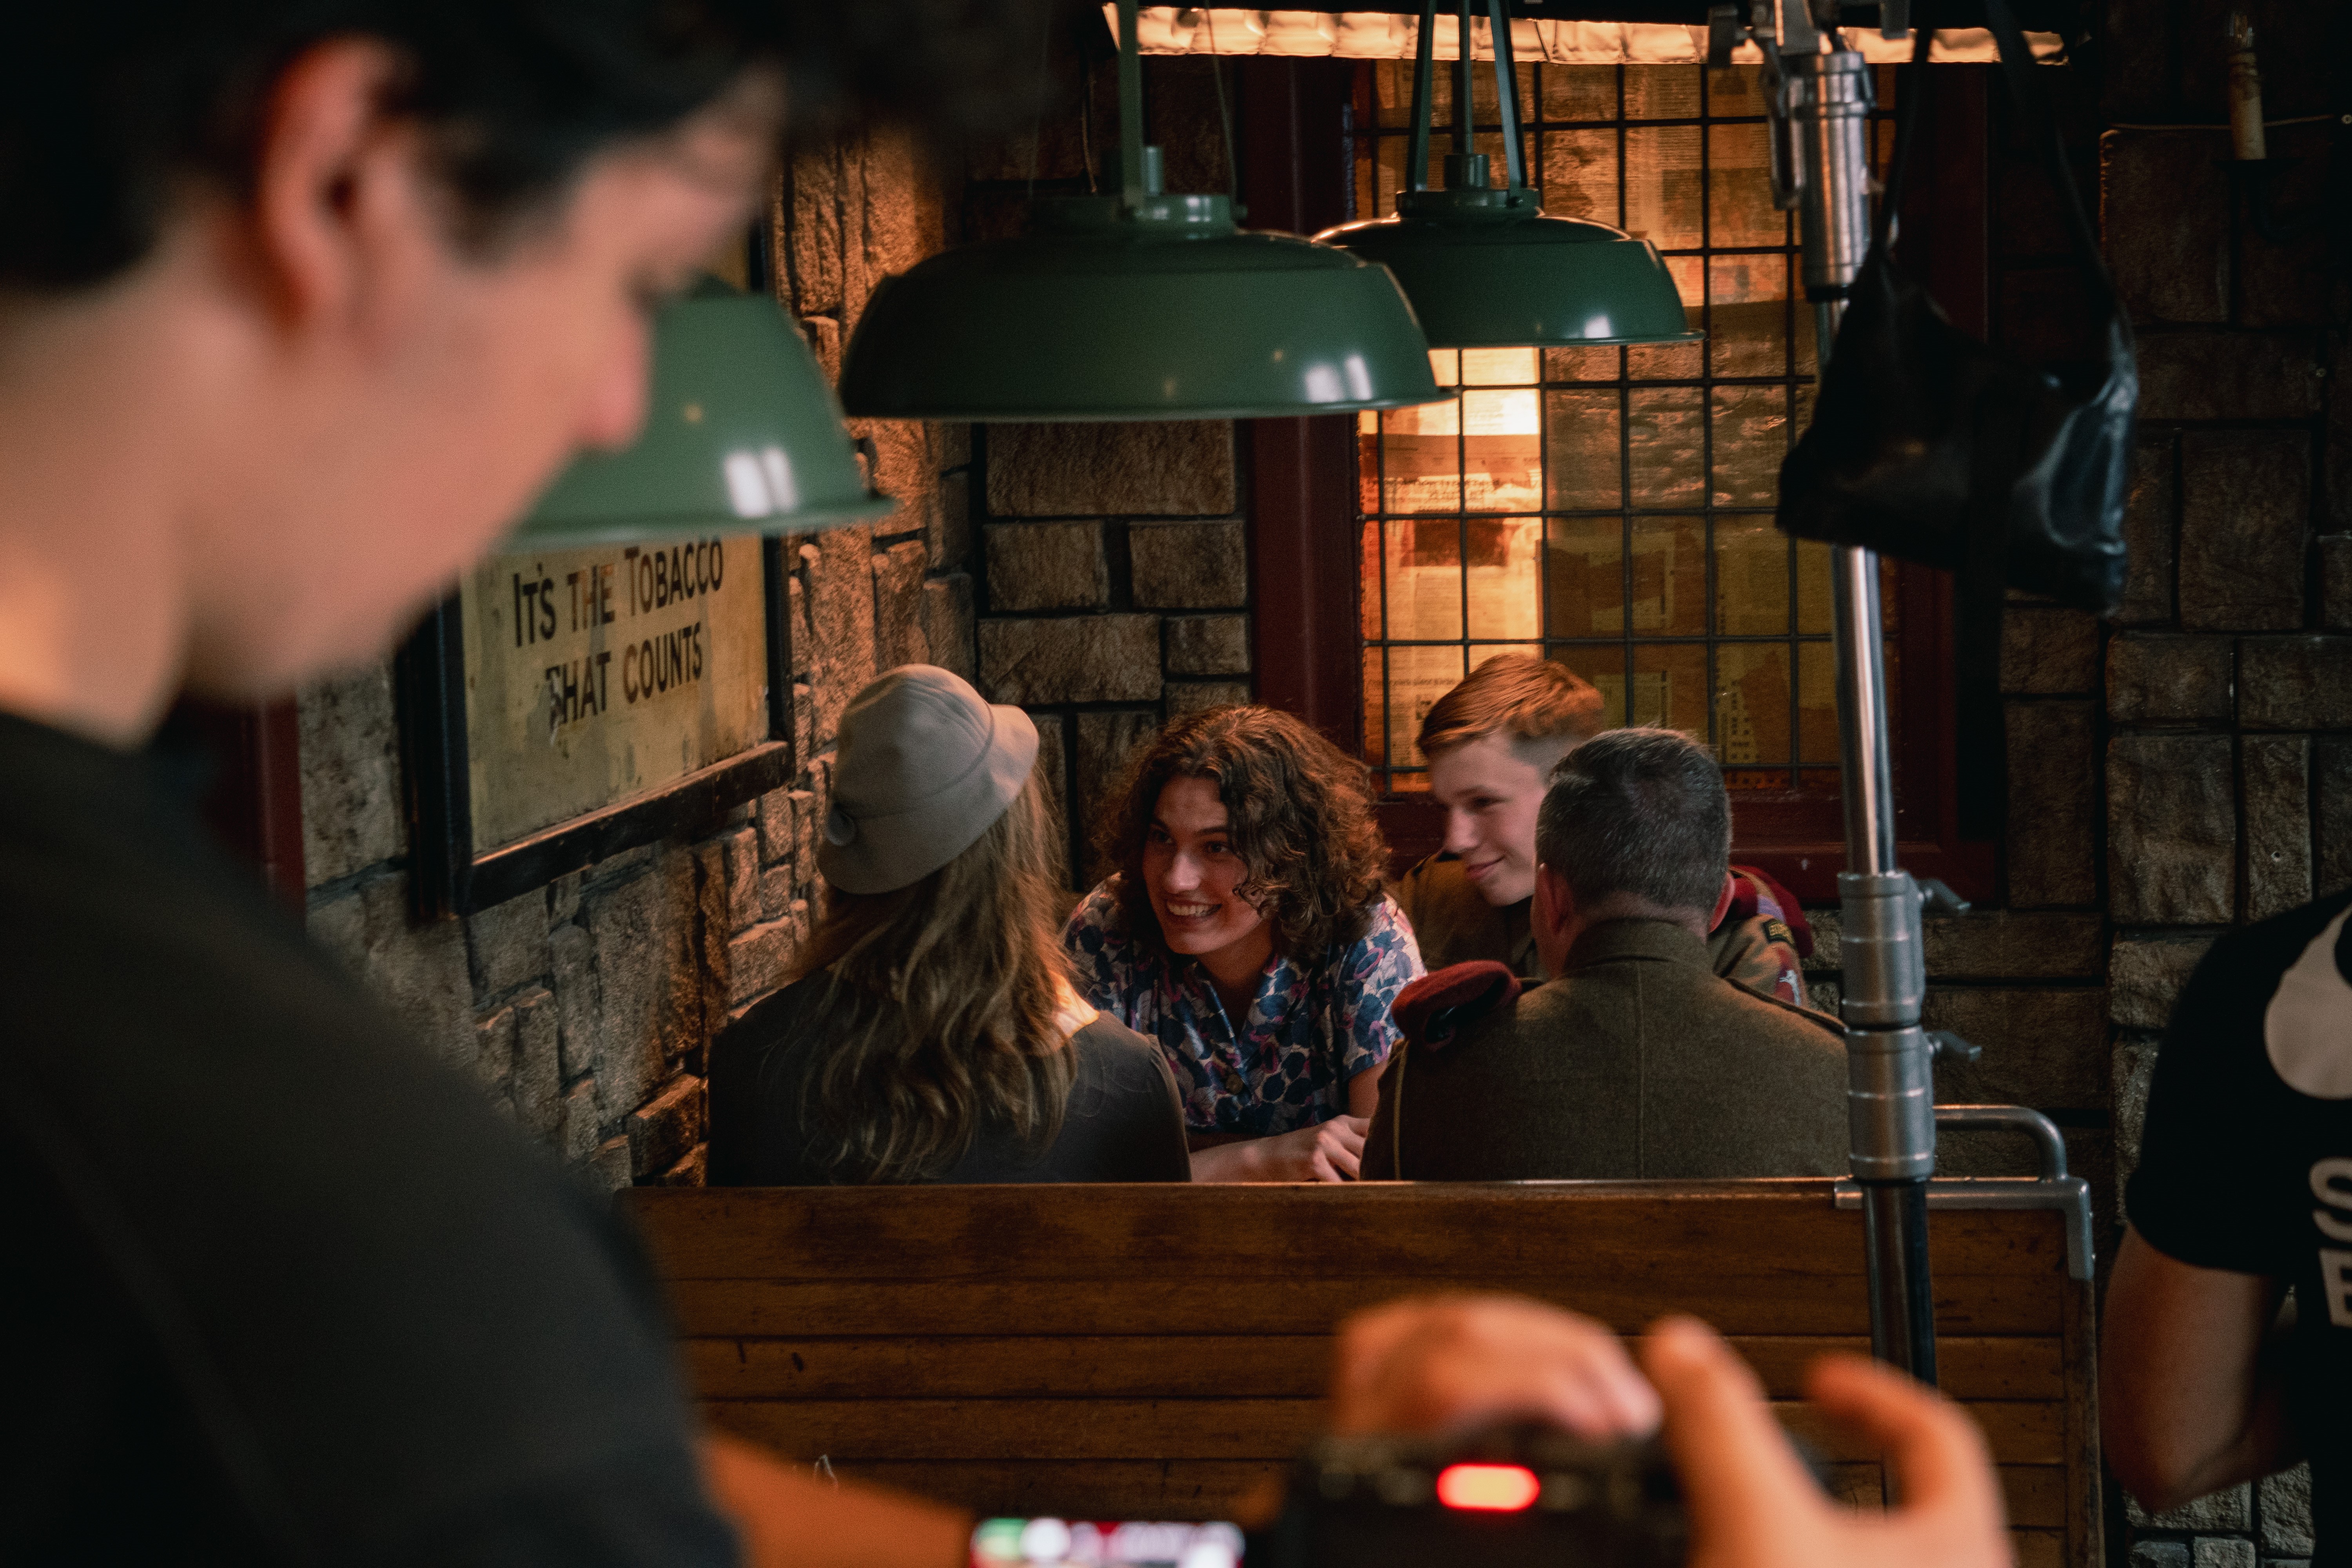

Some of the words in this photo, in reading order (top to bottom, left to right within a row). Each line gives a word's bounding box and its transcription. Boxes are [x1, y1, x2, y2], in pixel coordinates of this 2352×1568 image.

[513, 562, 557, 647] IT'S
[567, 564, 615, 633] THE
[624, 539, 723, 616] TOBACCO
[623, 622, 702, 703] COUNTS
